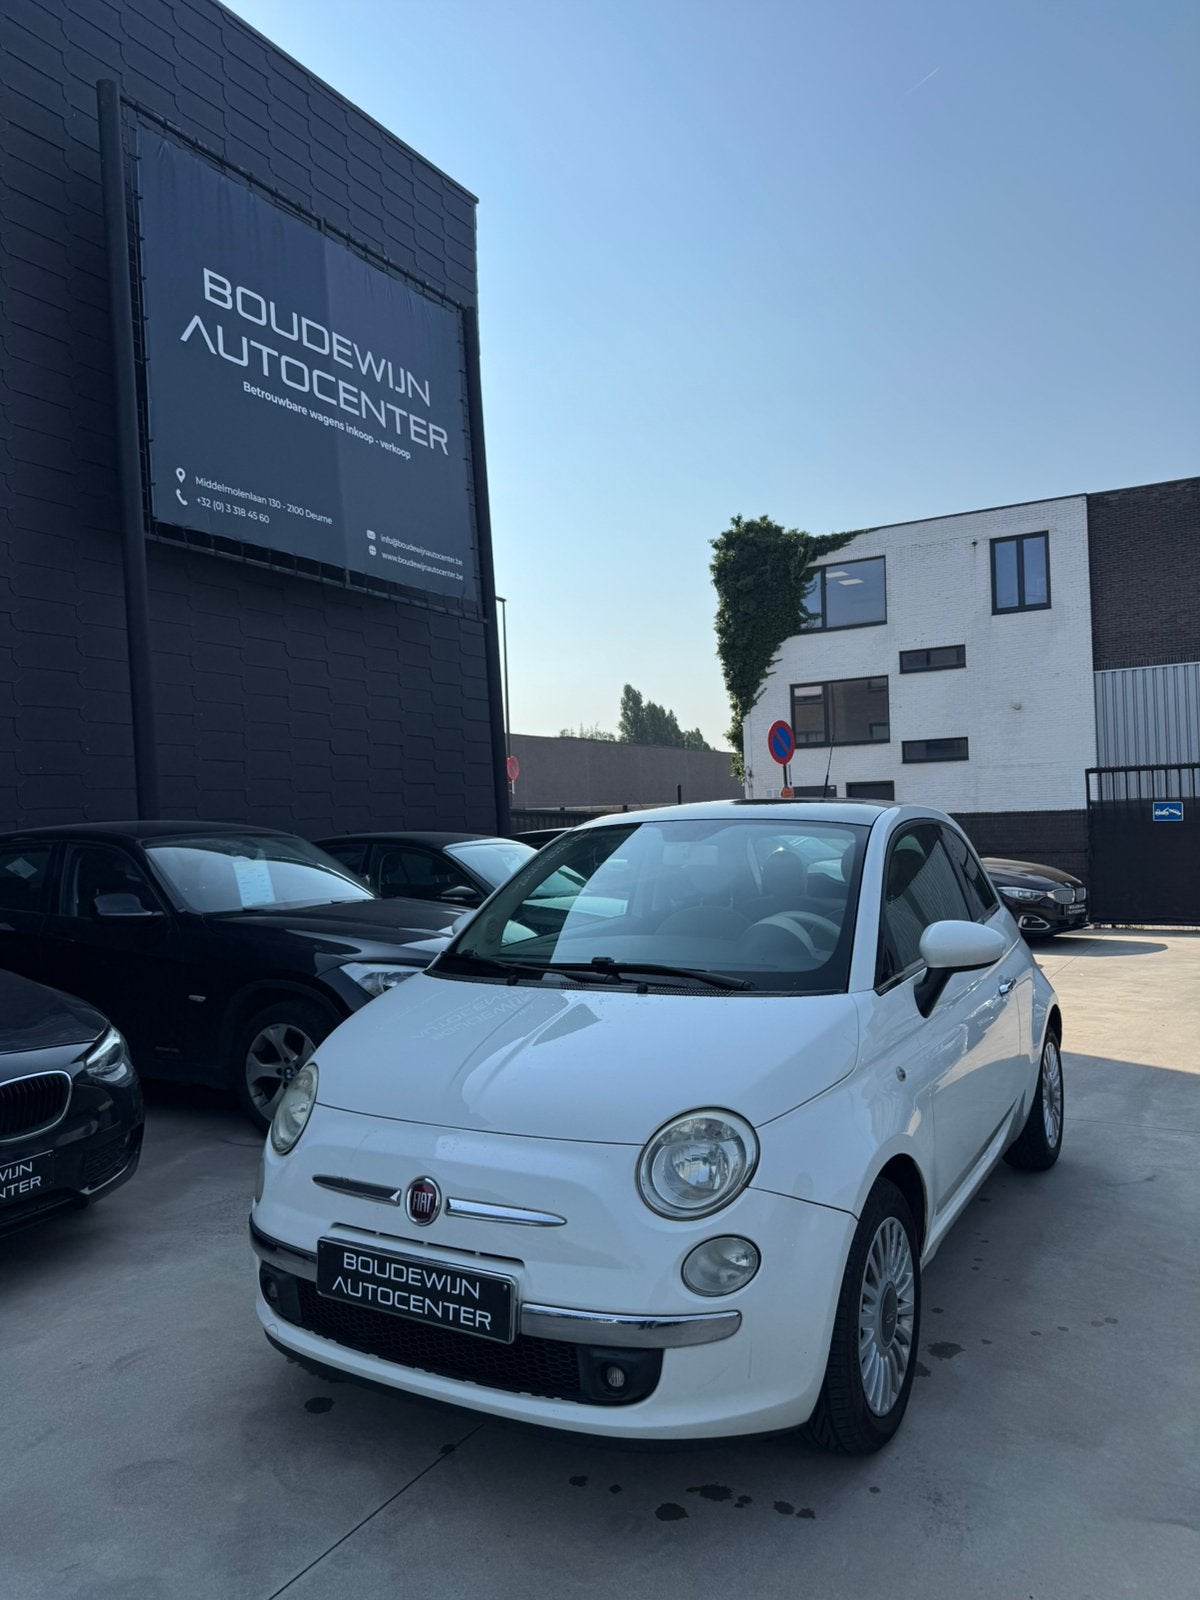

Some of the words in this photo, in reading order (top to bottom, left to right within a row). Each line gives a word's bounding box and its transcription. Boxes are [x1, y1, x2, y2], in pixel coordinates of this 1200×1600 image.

[203, 267, 431, 407] BOUDEWIJN
[180, 314, 450, 455] AUTOCENTER
[242, 381, 308, 416] Betrouwbare
[308, 409, 345, 432] wagens
[345, 422, 374, 445] inkoop
[379, 438, 412, 460] verkoop
[195, 476, 268, 506] Middelmolenlaan
[268, 497, 281, 509] 130
[286, 503, 305, 517] 2100
[305, 509, 333, 525] Deurne
[196, 497, 212, 509] +32
[213, 500, 225, 513] (0)
[225, 504, 232, 514] 3
[232, 505, 247, 517] 318
[247, 510, 258, 521] 45
[259, 514, 270, 524] 60
[412, 1191, 434, 1214] FIAT
[343, 1252, 480, 1300] BOUDEWIJN
[332, 1276, 492, 1331] AUTOCENTER
